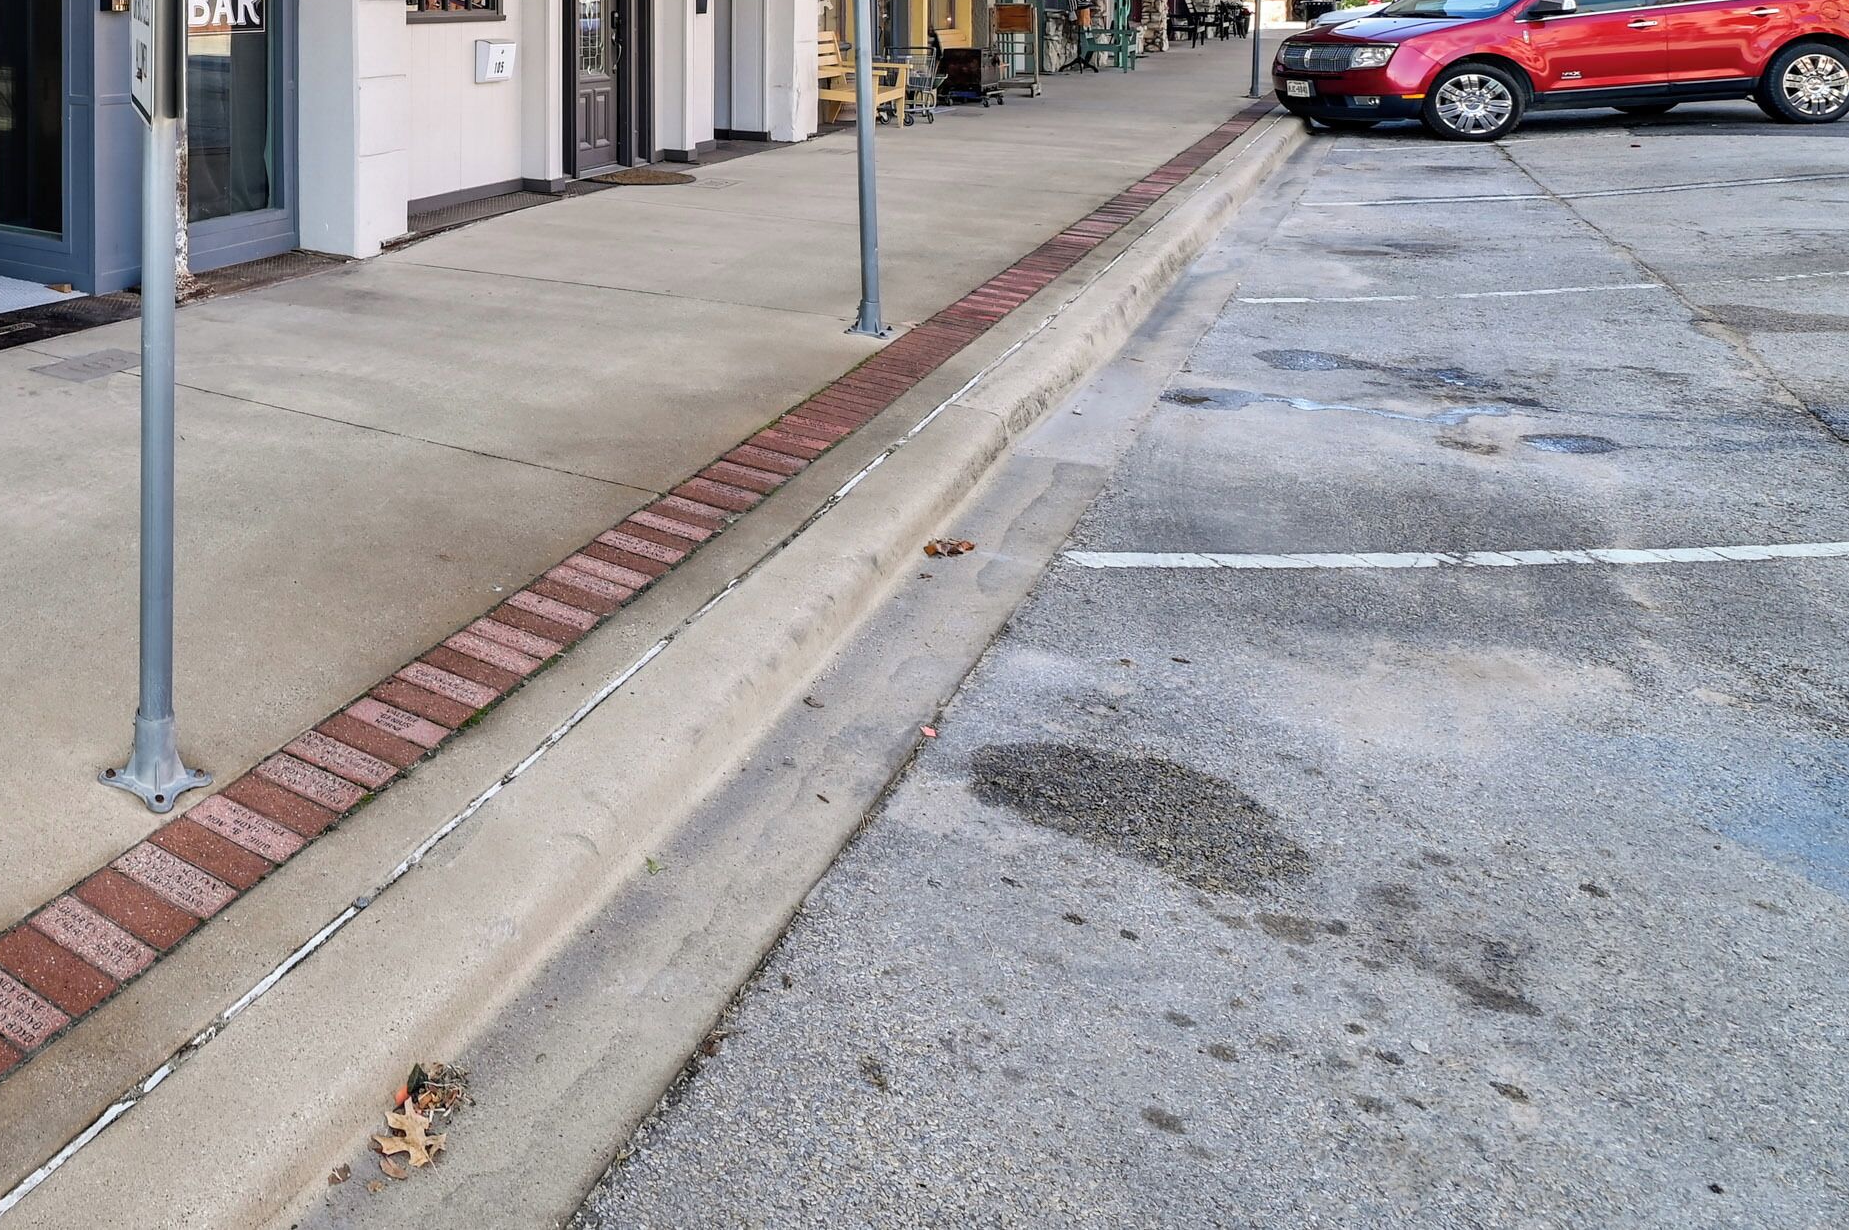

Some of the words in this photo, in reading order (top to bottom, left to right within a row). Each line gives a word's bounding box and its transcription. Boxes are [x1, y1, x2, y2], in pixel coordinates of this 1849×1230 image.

[16, 992, 47, 1012] GENE
[14, 1009, 44, 1030] BOYD
[6, 1022, 36, 1043] BOYD
